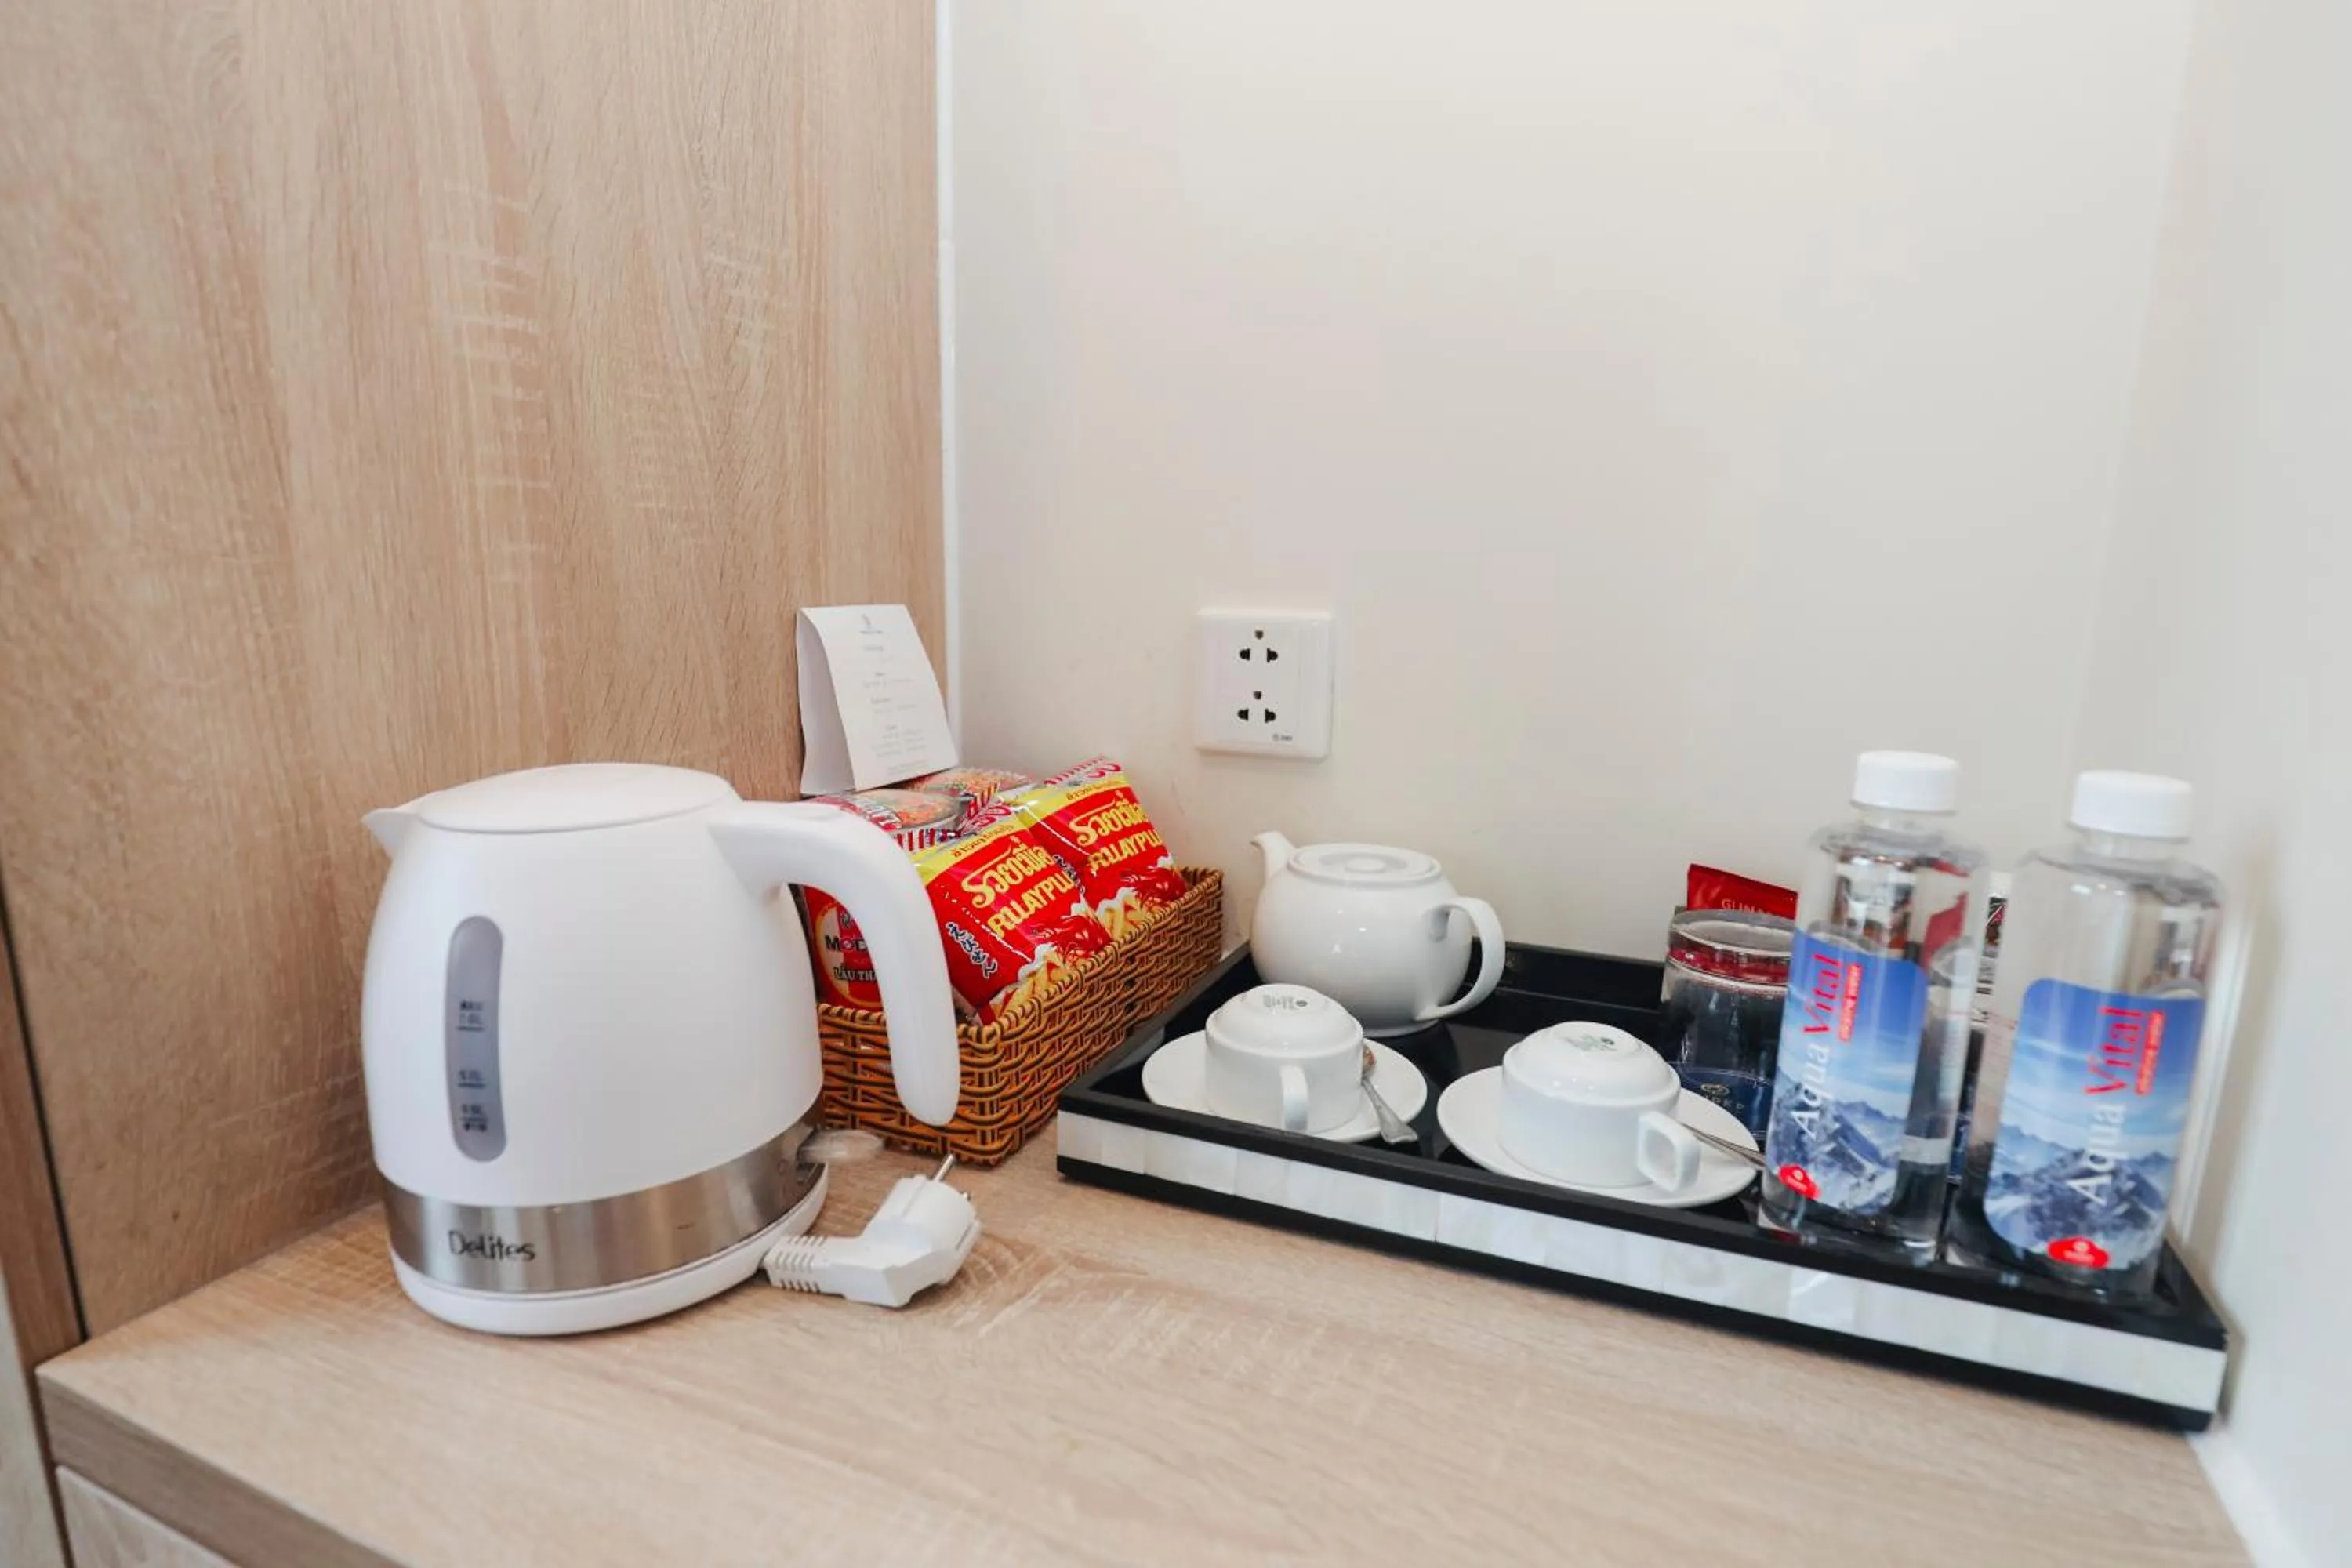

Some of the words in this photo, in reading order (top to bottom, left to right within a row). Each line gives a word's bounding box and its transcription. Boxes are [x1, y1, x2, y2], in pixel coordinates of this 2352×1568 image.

[1802, 953, 1842, 1034] Vital
[1791, 1043, 1832, 1140] Aqua
[2083, 1005, 2145, 1094] Vital
[2067, 1103, 2129, 1207] Aqua
[448, 1229, 536, 1263] Delites
